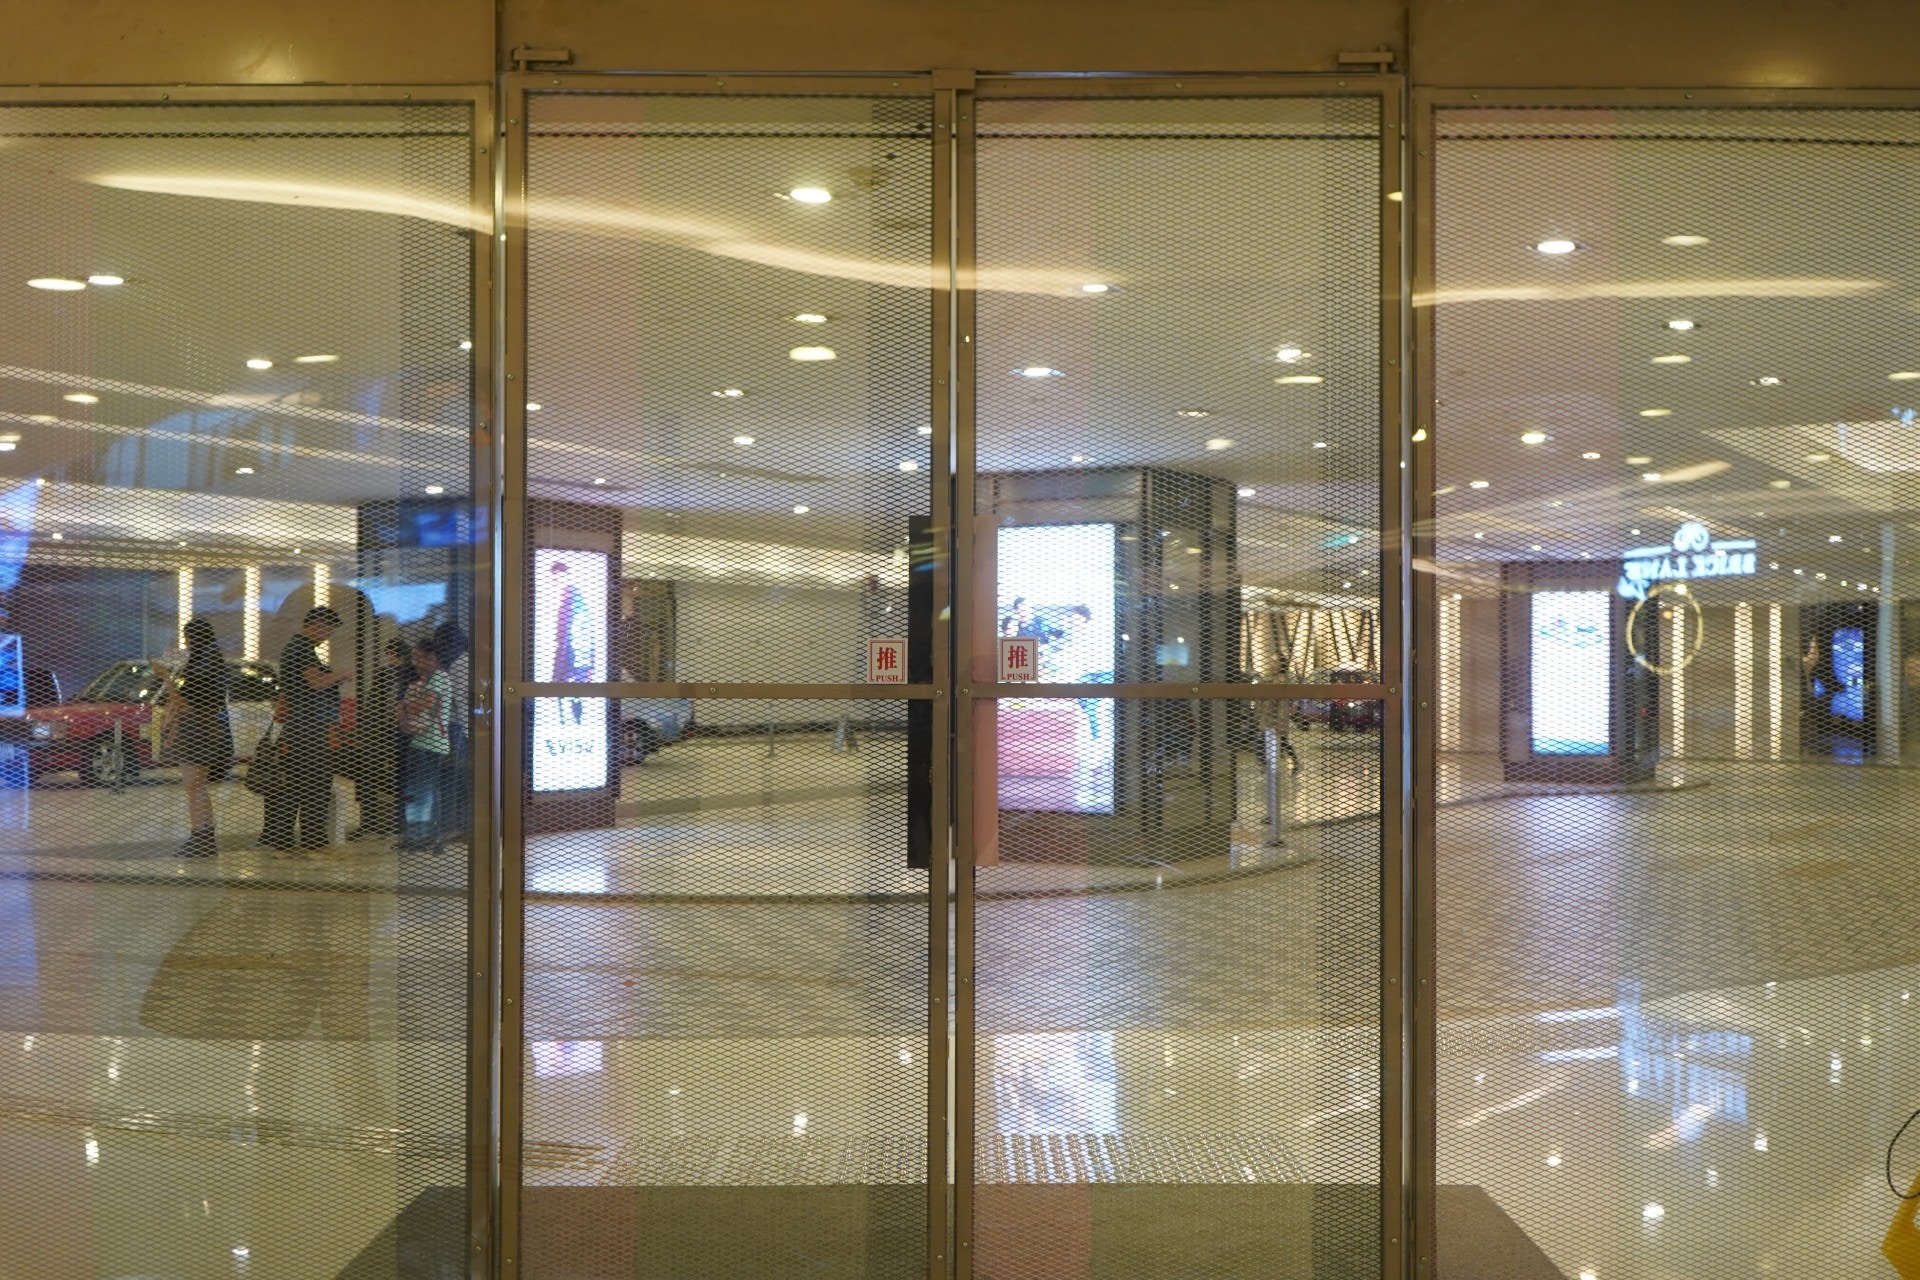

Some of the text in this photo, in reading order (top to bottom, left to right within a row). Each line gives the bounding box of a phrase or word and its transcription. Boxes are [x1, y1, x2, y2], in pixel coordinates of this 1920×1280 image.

[876, 646, 898, 671] 推
[1007, 645, 1029, 669] 推
[1006, 673, 1030, 681] PUSH
